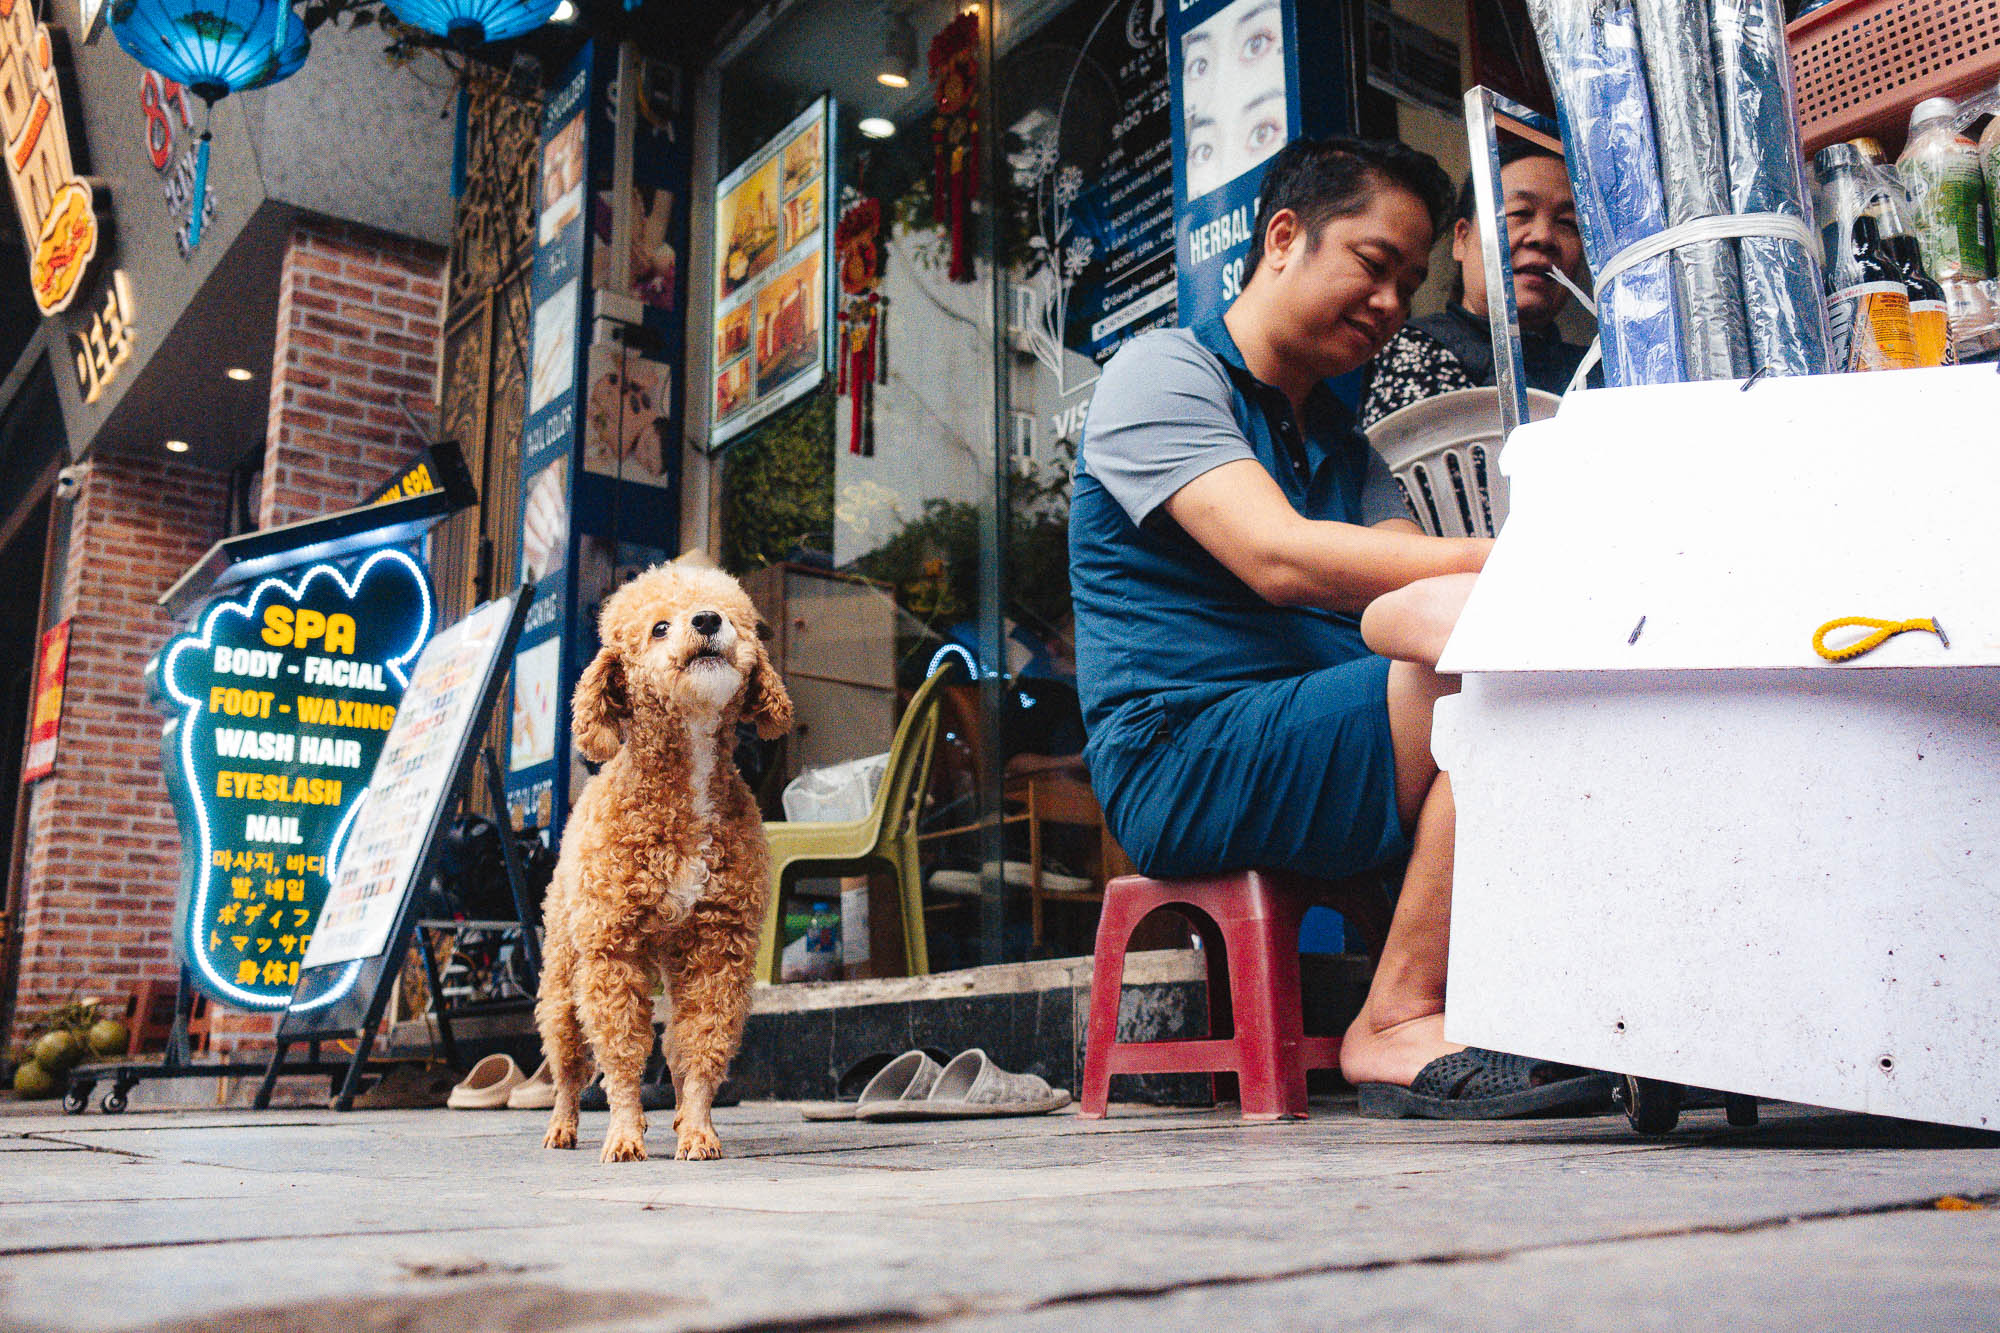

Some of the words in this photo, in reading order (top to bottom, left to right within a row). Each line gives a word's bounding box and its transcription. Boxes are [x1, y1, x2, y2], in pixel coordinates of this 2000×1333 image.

[1189, 204, 1252, 265] HERBAL
[261, 604, 357, 655] SPA
[213, 645, 284, 679] BODY
[304, 656, 387, 692] FACIAL
[209, 686, 275, 719] FOOT
[297, 695, 396, 731] WAXING
[215, 728, 295, 762] WASH
[299, 735, 362, 769] HAIR
[216, 770, 342, 806] EYESLASH
[245, 814, 304, 845] NAIL
[213, 849, 280, 876] 마사지,
[286, 854, 325, 877] 바디
[265, 878, 305, 902] 네일
